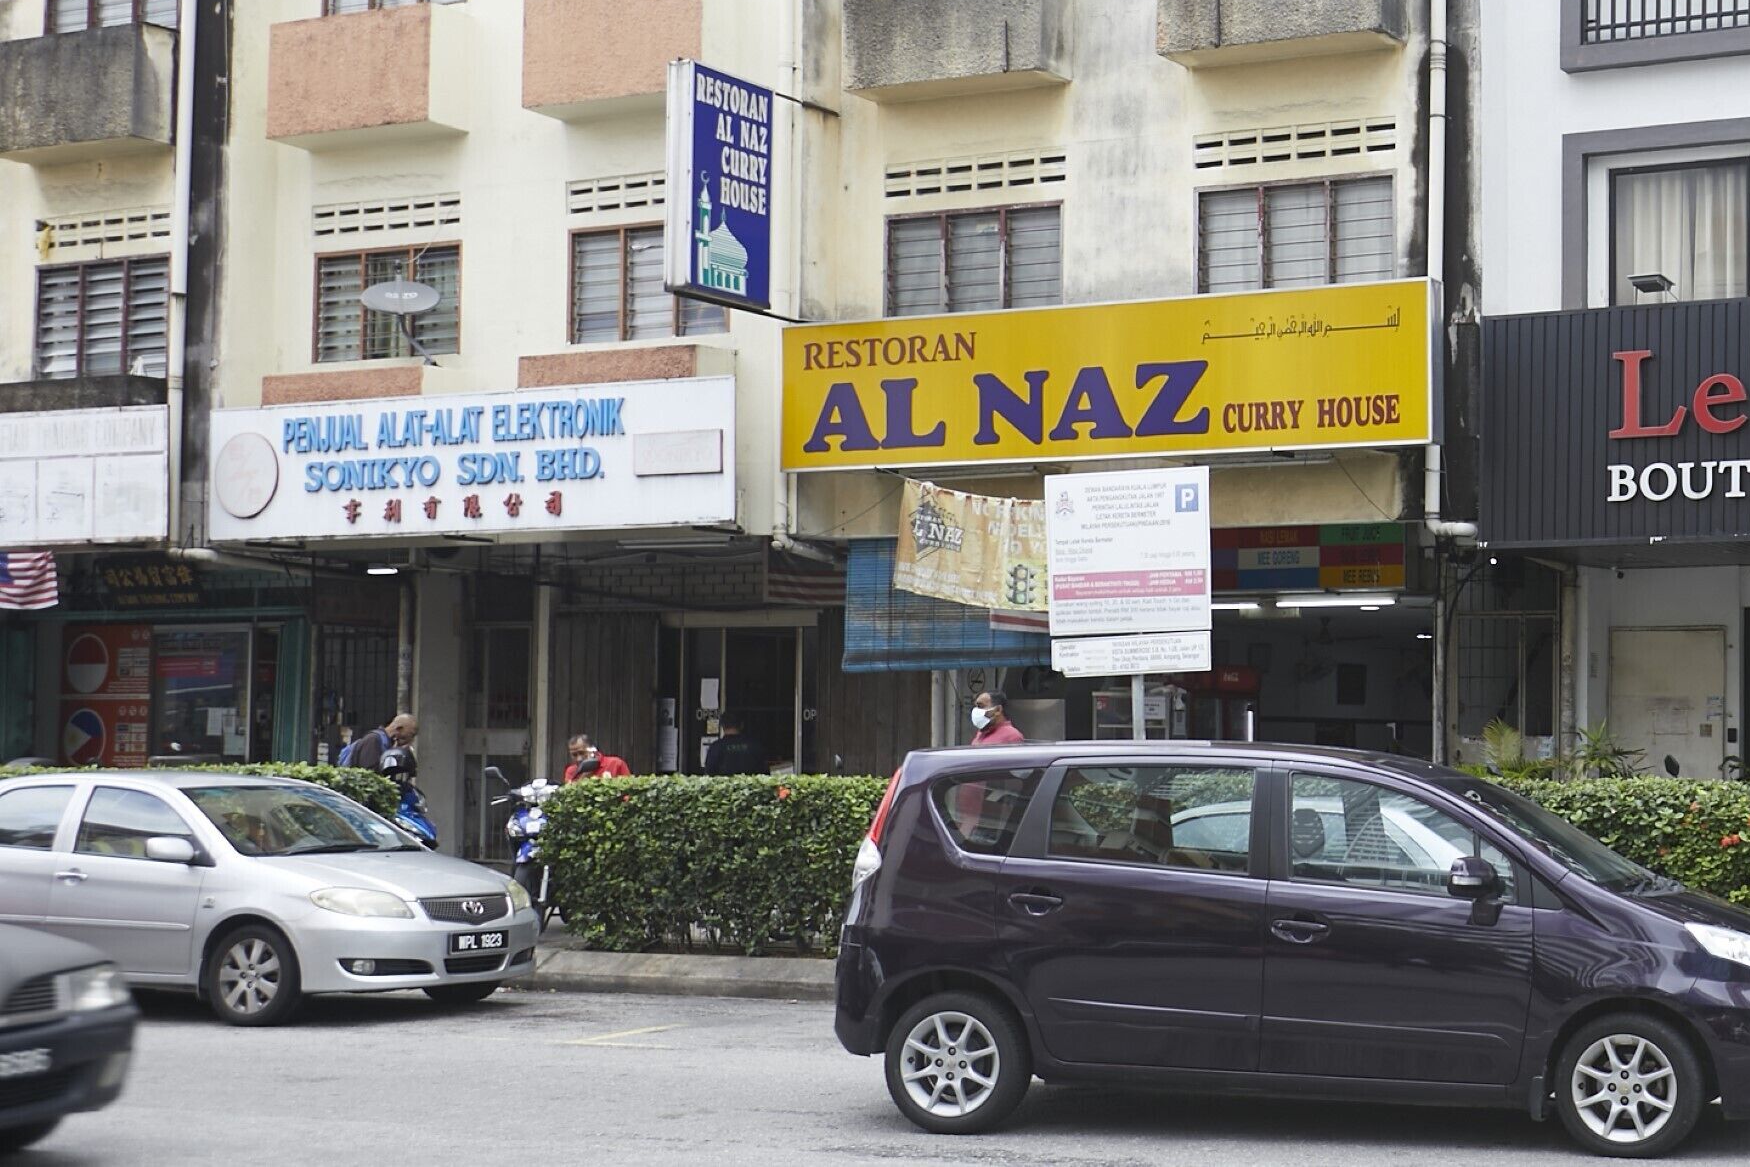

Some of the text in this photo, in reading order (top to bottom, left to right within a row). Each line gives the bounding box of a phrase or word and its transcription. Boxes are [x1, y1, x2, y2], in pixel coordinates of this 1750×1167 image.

[696, 72, 768, 124] RESTORAN
[716, 112, 768, 155] AL NAZ
[721, 146, 767, 185] CURRY
[720, 176, 766, 216] HOUSE
[803, 331, 977, 371] RESTORAN
[803, 360, 1401, 452] AL NAZ CURRY HOUSE
[1609, 349, 1748, 439] Le
[283, 397, 625, 454] PENJUAL ALAT-ALAT ELEKTRONIK
[305, 455, 440, 493] SONIKYO
[457, 451, 525, 485] SDN.
[535, 447, 605, 482] BHD.
[1182, 489, 1195, 508] P
[459, 932, 502, 950] WPL 1923
